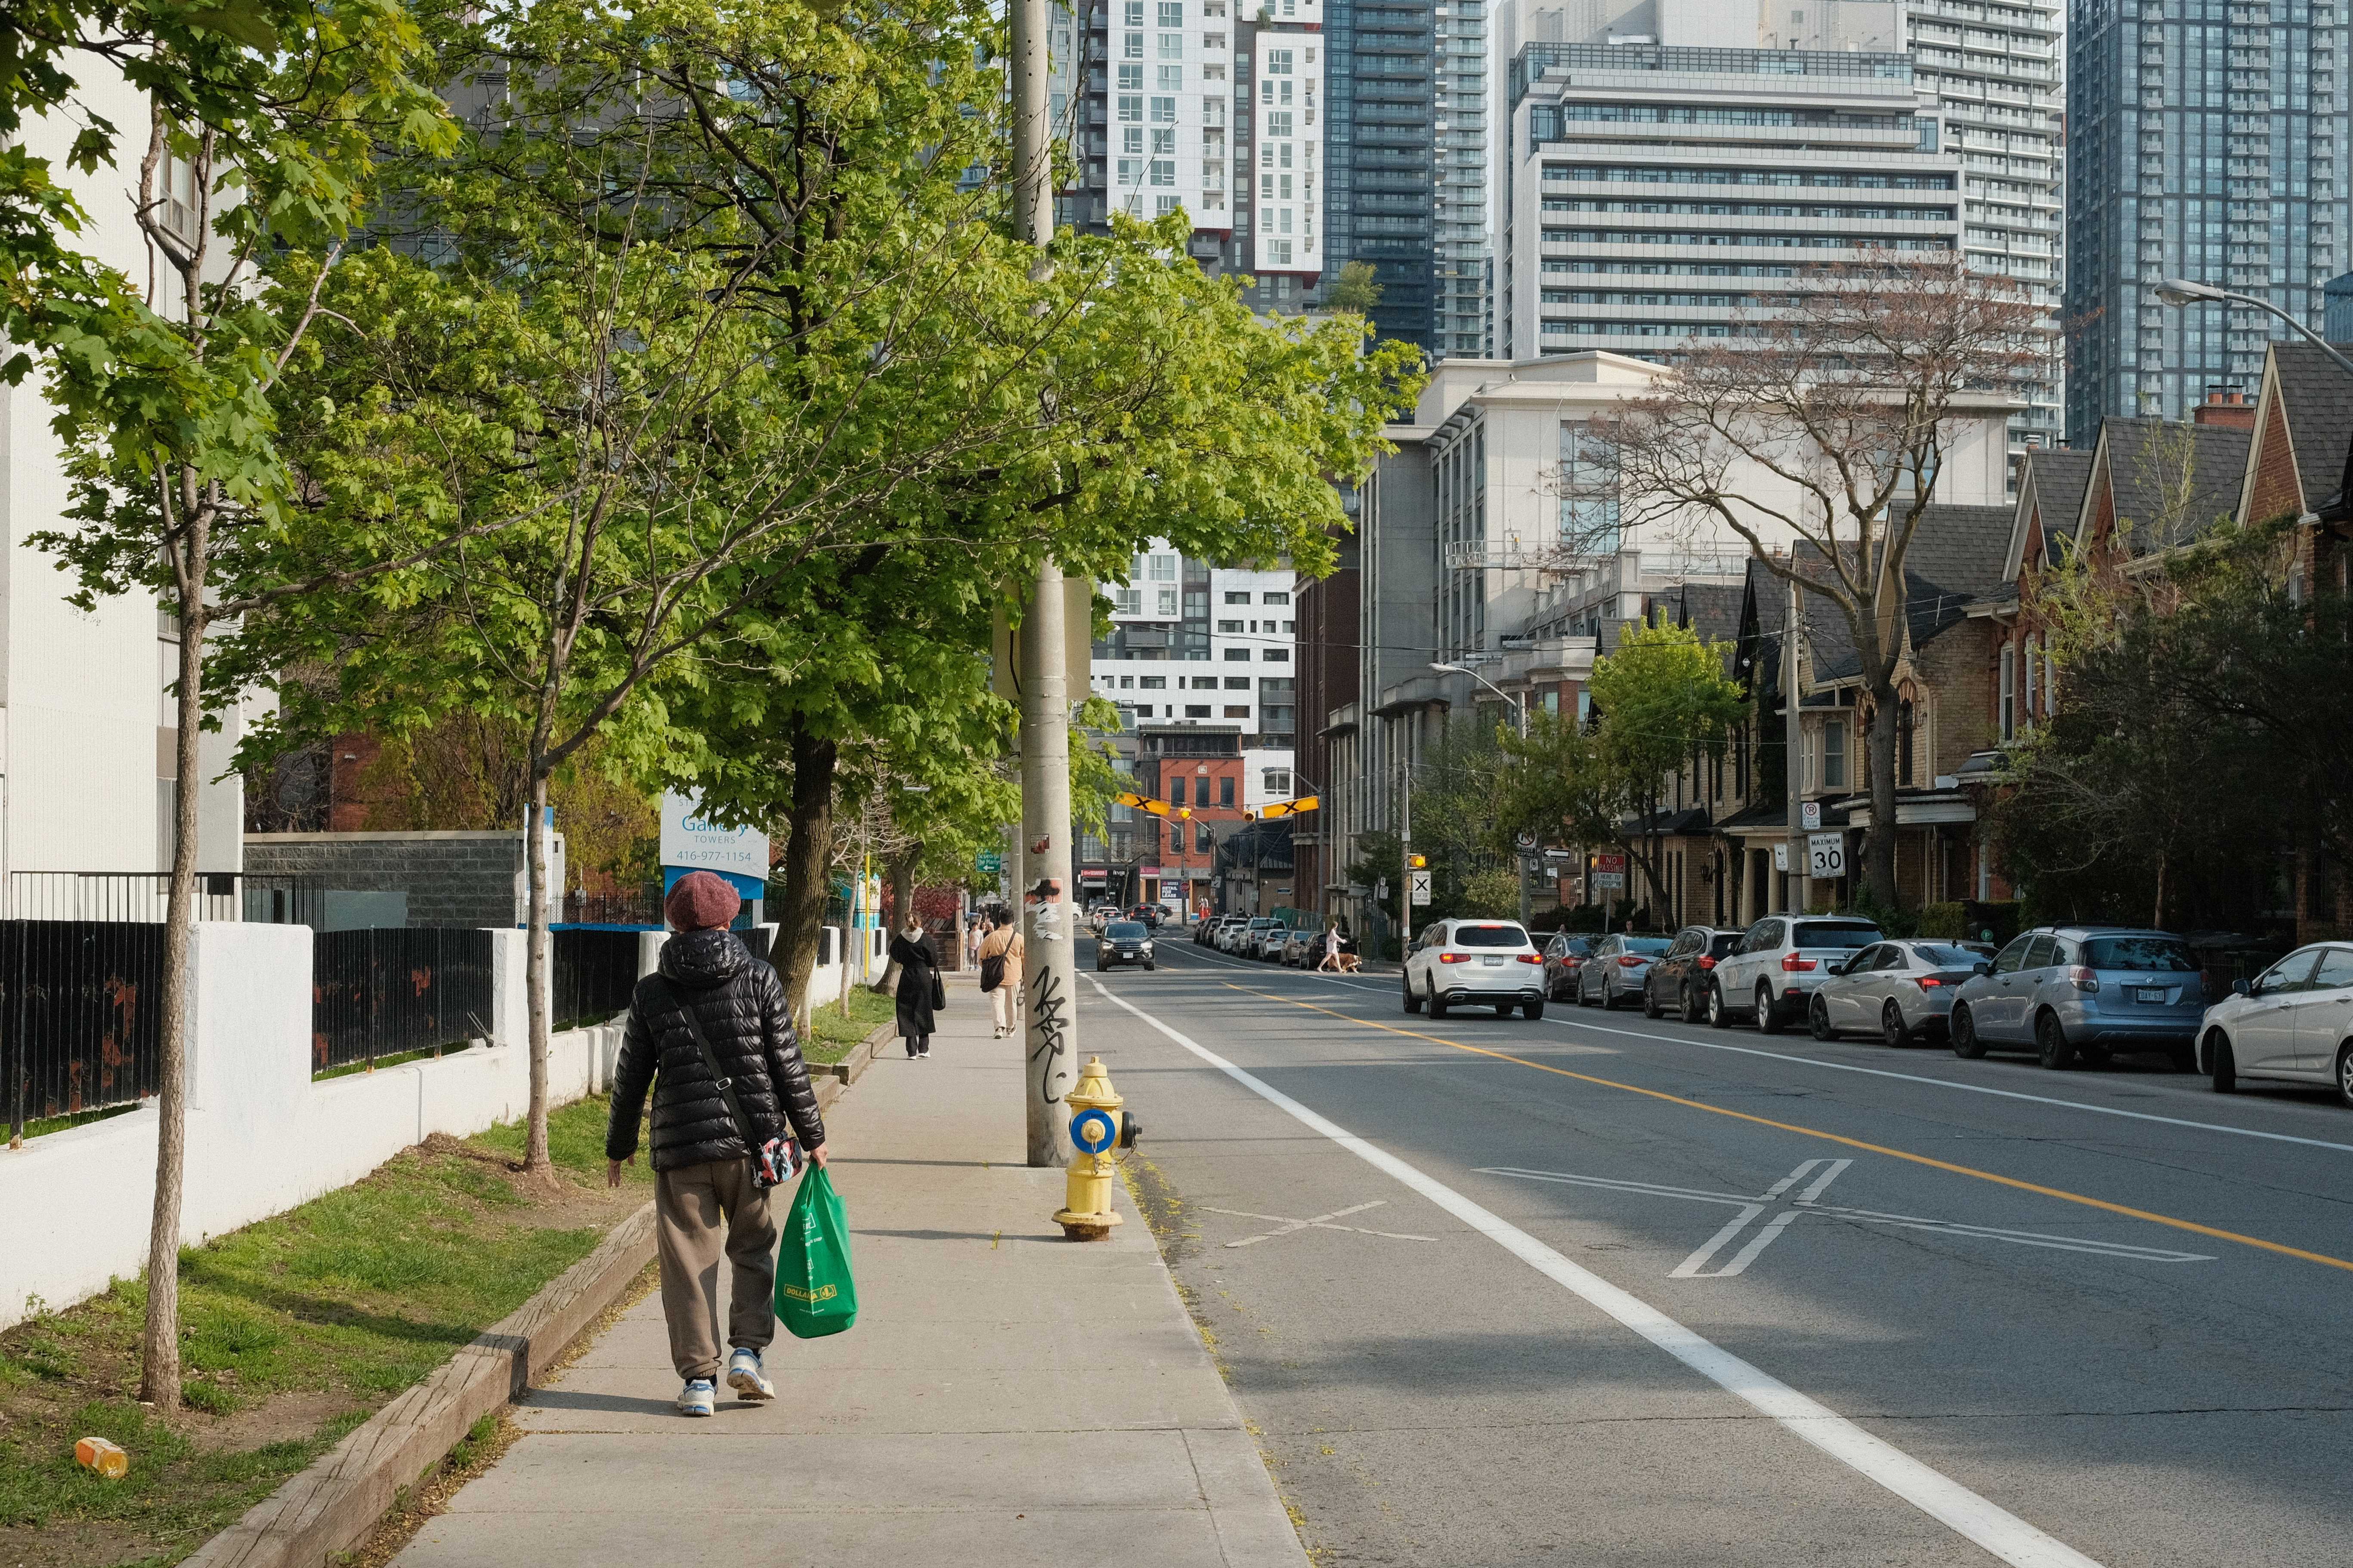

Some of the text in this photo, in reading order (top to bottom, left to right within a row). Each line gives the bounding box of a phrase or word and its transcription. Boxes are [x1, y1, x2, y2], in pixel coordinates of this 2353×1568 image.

[682, 815, 747, 836] Gaey
[694, 835, 736, 843] TOWERS
[1811, 838, 1840, 846] MAXIMUM
[677, 851, 751, 861] 416-977-1154
[1606, 856, 1617, 864] NO
[1815, 850, 1841, 869] 30
[1599, 864, 1623, 872] PASSING
[787, 1287, 818, 1299] DOLLAA
